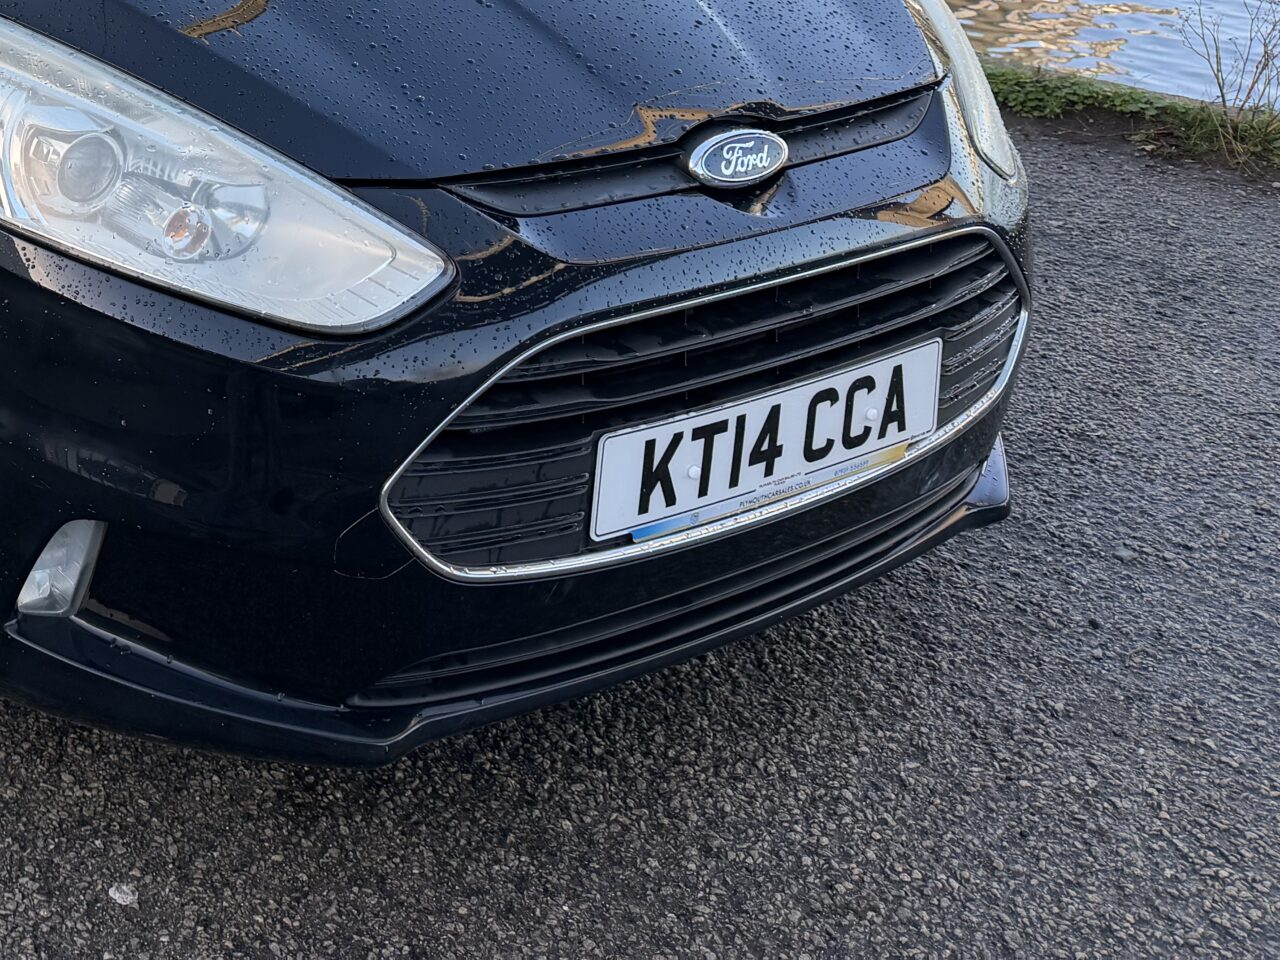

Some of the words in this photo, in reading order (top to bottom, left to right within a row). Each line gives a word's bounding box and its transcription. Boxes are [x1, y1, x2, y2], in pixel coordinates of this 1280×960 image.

[721, 141, 770, 176] Ford
[637, 403, 784, 516] KT14
[802, 363, 907, 464] CCA
